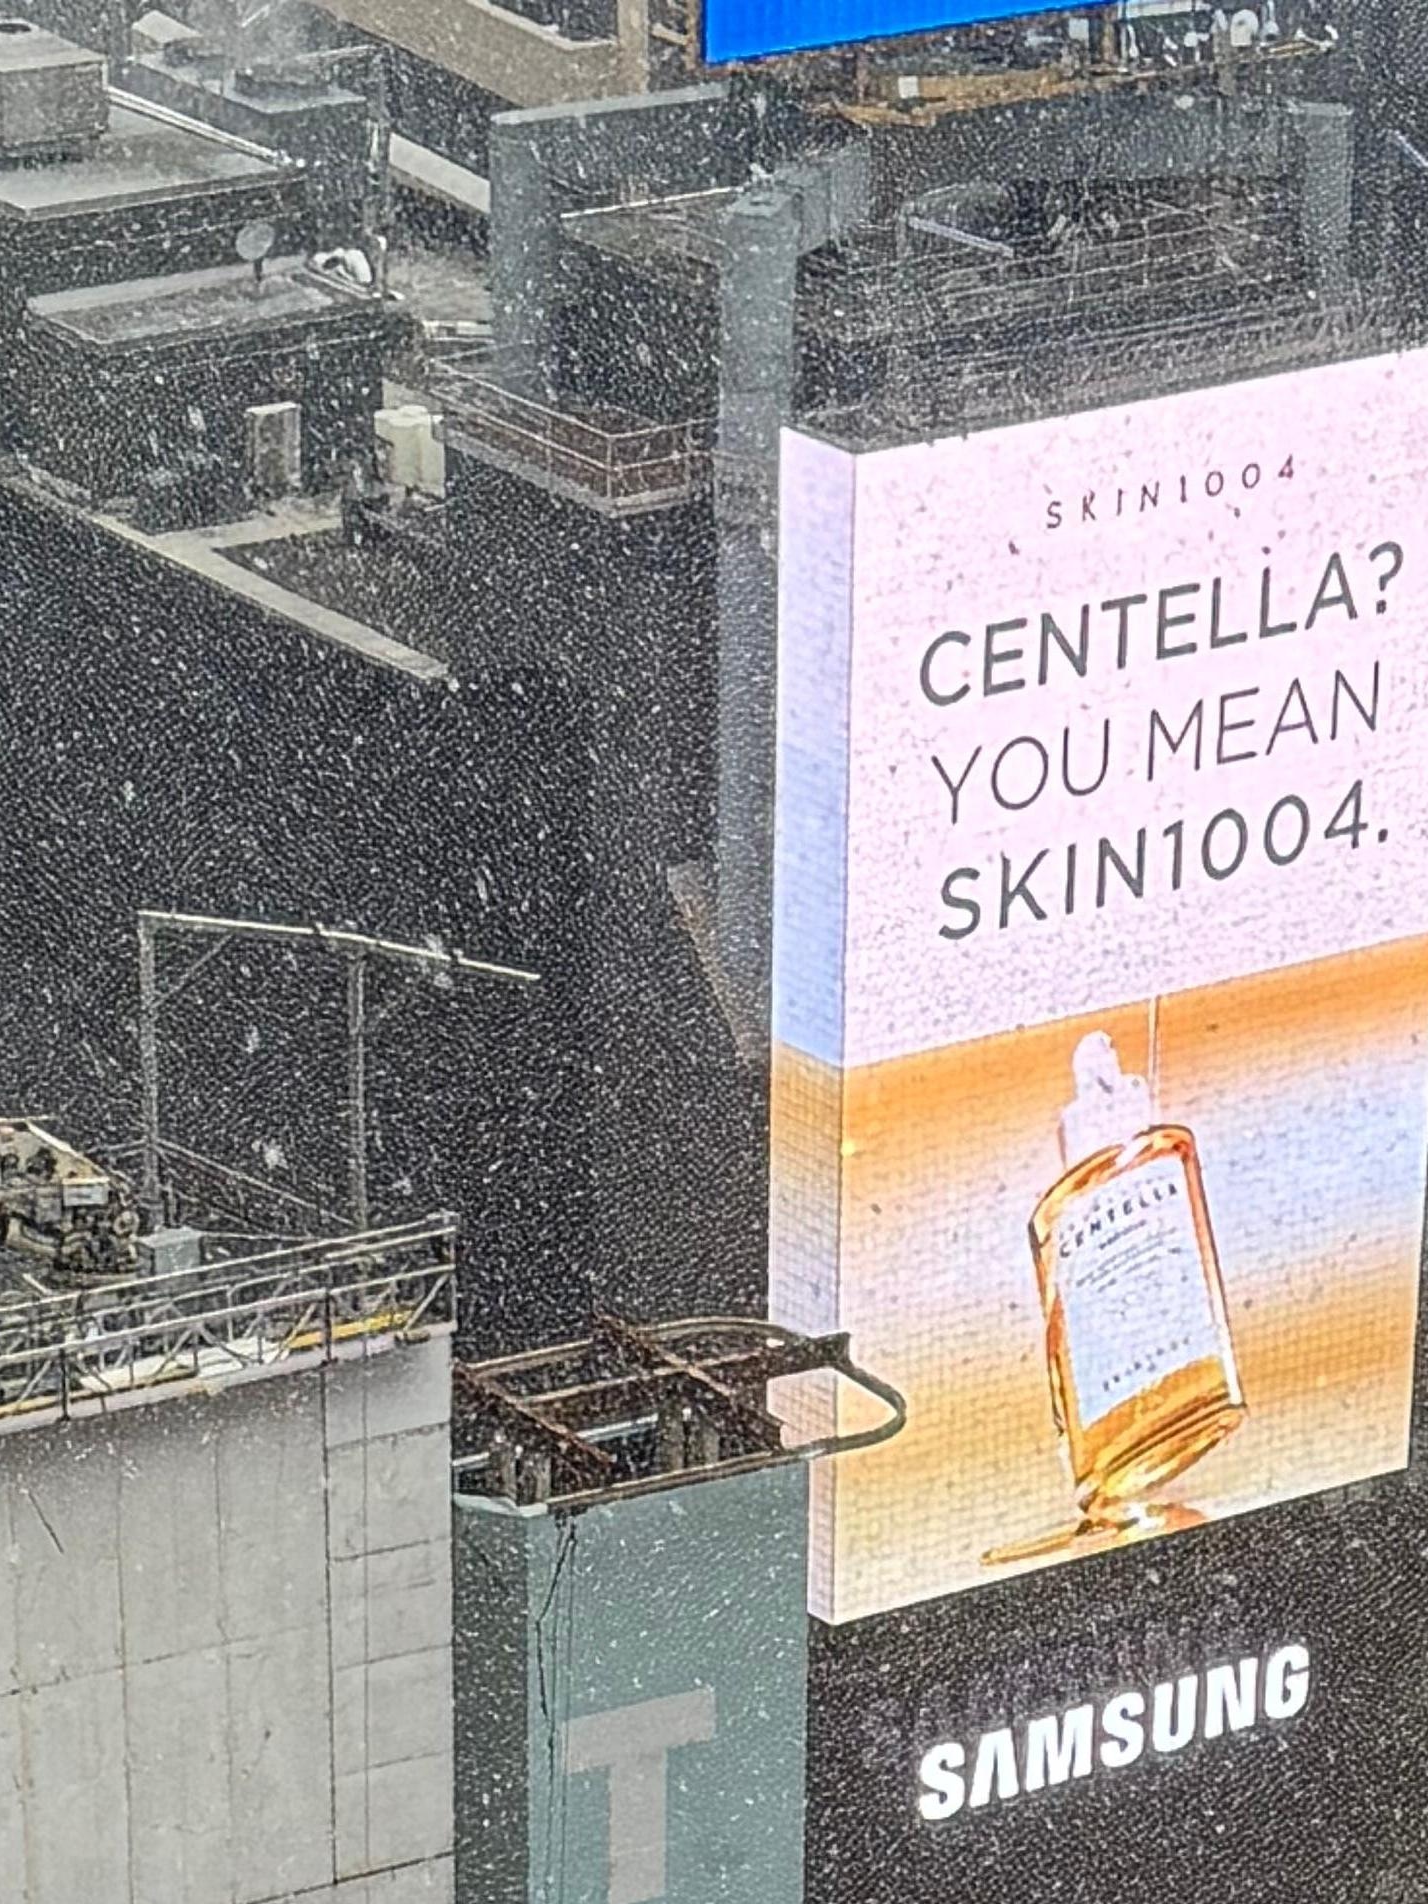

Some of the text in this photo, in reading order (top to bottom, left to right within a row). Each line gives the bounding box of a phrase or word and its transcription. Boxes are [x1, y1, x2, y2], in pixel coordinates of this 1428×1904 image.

[1045, 454, 1296, 529] SKIN1004
[919, 540, 1404, 707] CENTELLA?
[930, 660, 1381, 825] YOU MEAN
[938, 779, 1389, 940] SKIN1004.
[917, 1644, 1311, 1821] SAMSUNG
